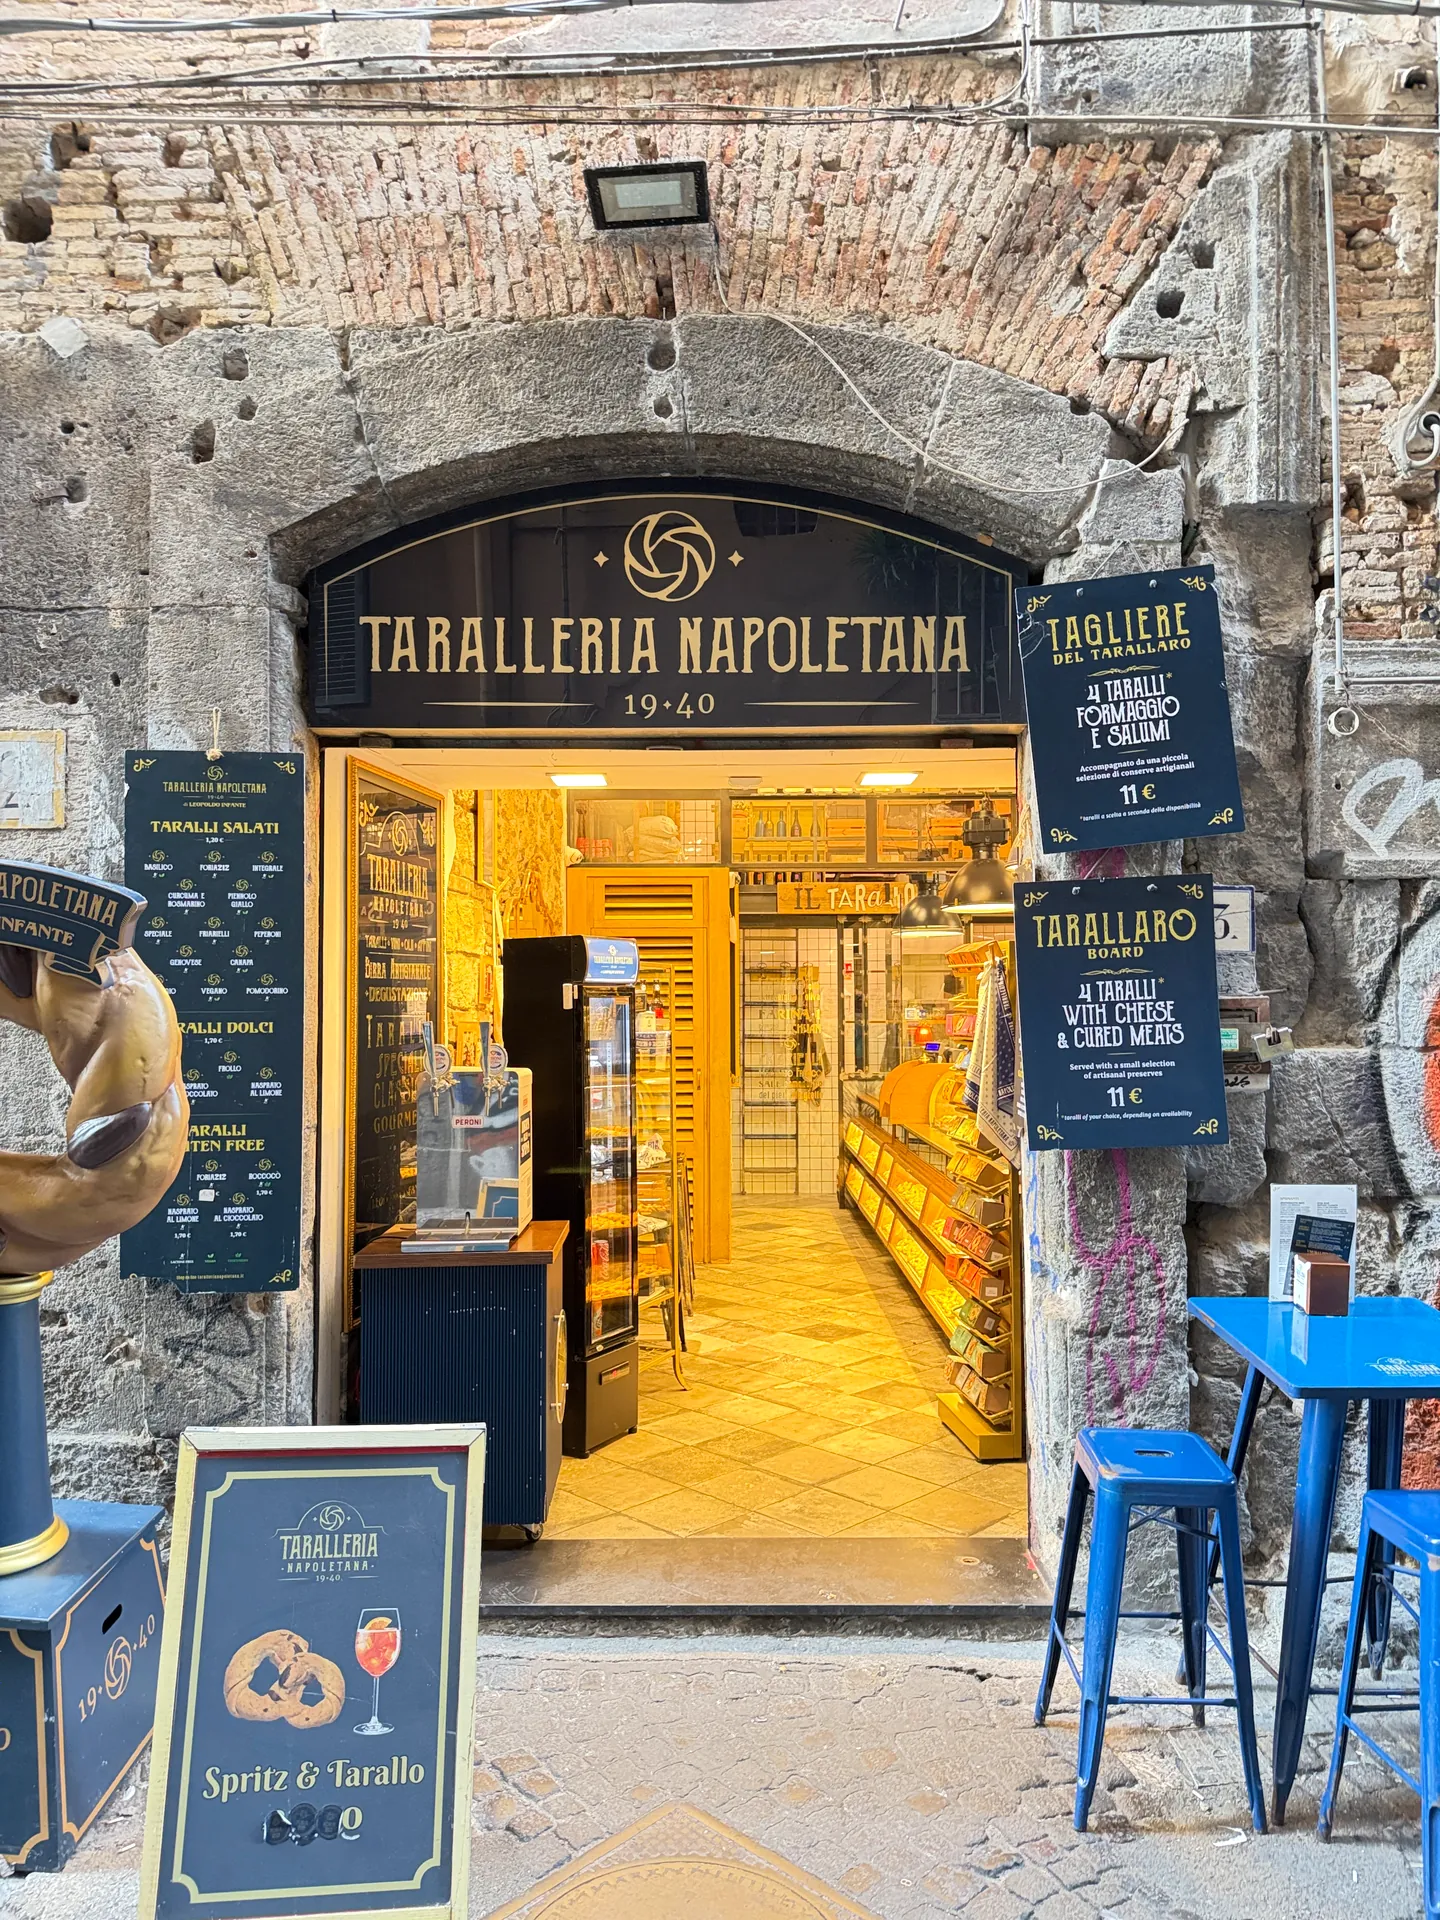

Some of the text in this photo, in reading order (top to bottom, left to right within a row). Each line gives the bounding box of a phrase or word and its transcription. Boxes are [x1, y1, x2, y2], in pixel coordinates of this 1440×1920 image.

[1046, 602, 1190, 651] TAGLIERE
[359, 614, 970, 675] TARALLERIA NAPOLETANA
[1053, 637, 1192, 666] DEL TARALLARO
[1086, 683, 1101, 703] 4
[1076, 696, 1180, 728] FORMAGGIO
[1091, 719, 1171, 749] E SALUMI
[1075, 761, 1195, 782] selezione di conserve artigianali
[1080, 761, 1135, 772] Accompagnato
[1136, 758, 1145, 766] da
[1162, 753, 1189, 763] piccola
[162, 781, 267, 794] TARALLERIA NAPOLETANA
[1119, 783, 1156, 805] 11 €
[150, 820, 279, 834] TARALLI SALATI
[367, 853, 429, 900] TARALLERIA
[0, 872, 119, 928] APOLETANA
[373, 895, 424, 918] NAPOLETANA
[794, 887, 821, 910] IL
[0, 916, 75, 946] NFANTE
[1032, 908, 1197, 948] TARALLARO
[1087, 946, 1144, 960] BOARD
[1078, 984, 1092, 1003] 4
[1061, 1001, 1176, 1026] WITH CHEESE
[177, 1021, 274, 1034] RALLI DOLCI
[365, 1014, 424, 1049] TARALL
[1057, 1023, 1185, 1049] & CURED MEATS
[1069, 1062, 1094, 1070] Served
[1095, 1061, 1113, 1069] with
[1120, 1060, 1140, 1069] small
[1141, 1059, 1176, 1068] selection
[1093, 1071, 1126, 1079] artisanal
[1127, 1070, 1163, 1079] preserves
[1106, 1086, 1143, 1107] 11 €
[373, 1109, 417, 1134] GOURME
[455, 1118, 482, 1126] PERONI
[1082, 1113, 1089, 1121] of
[1122, 1111, 1151, 1120] depending
[1160, 1110, 1193, 1118] availability
[188, 1124, 247, 1137] ARALLI
[226, 1139, 265, 1151] FREE
[280, 1533, 378, 1560] TARALLERIA
[287, 1560, 368, 1573] NAPOLETANA
[202, 1755, 426, 1804] Spritz & Tarallo
